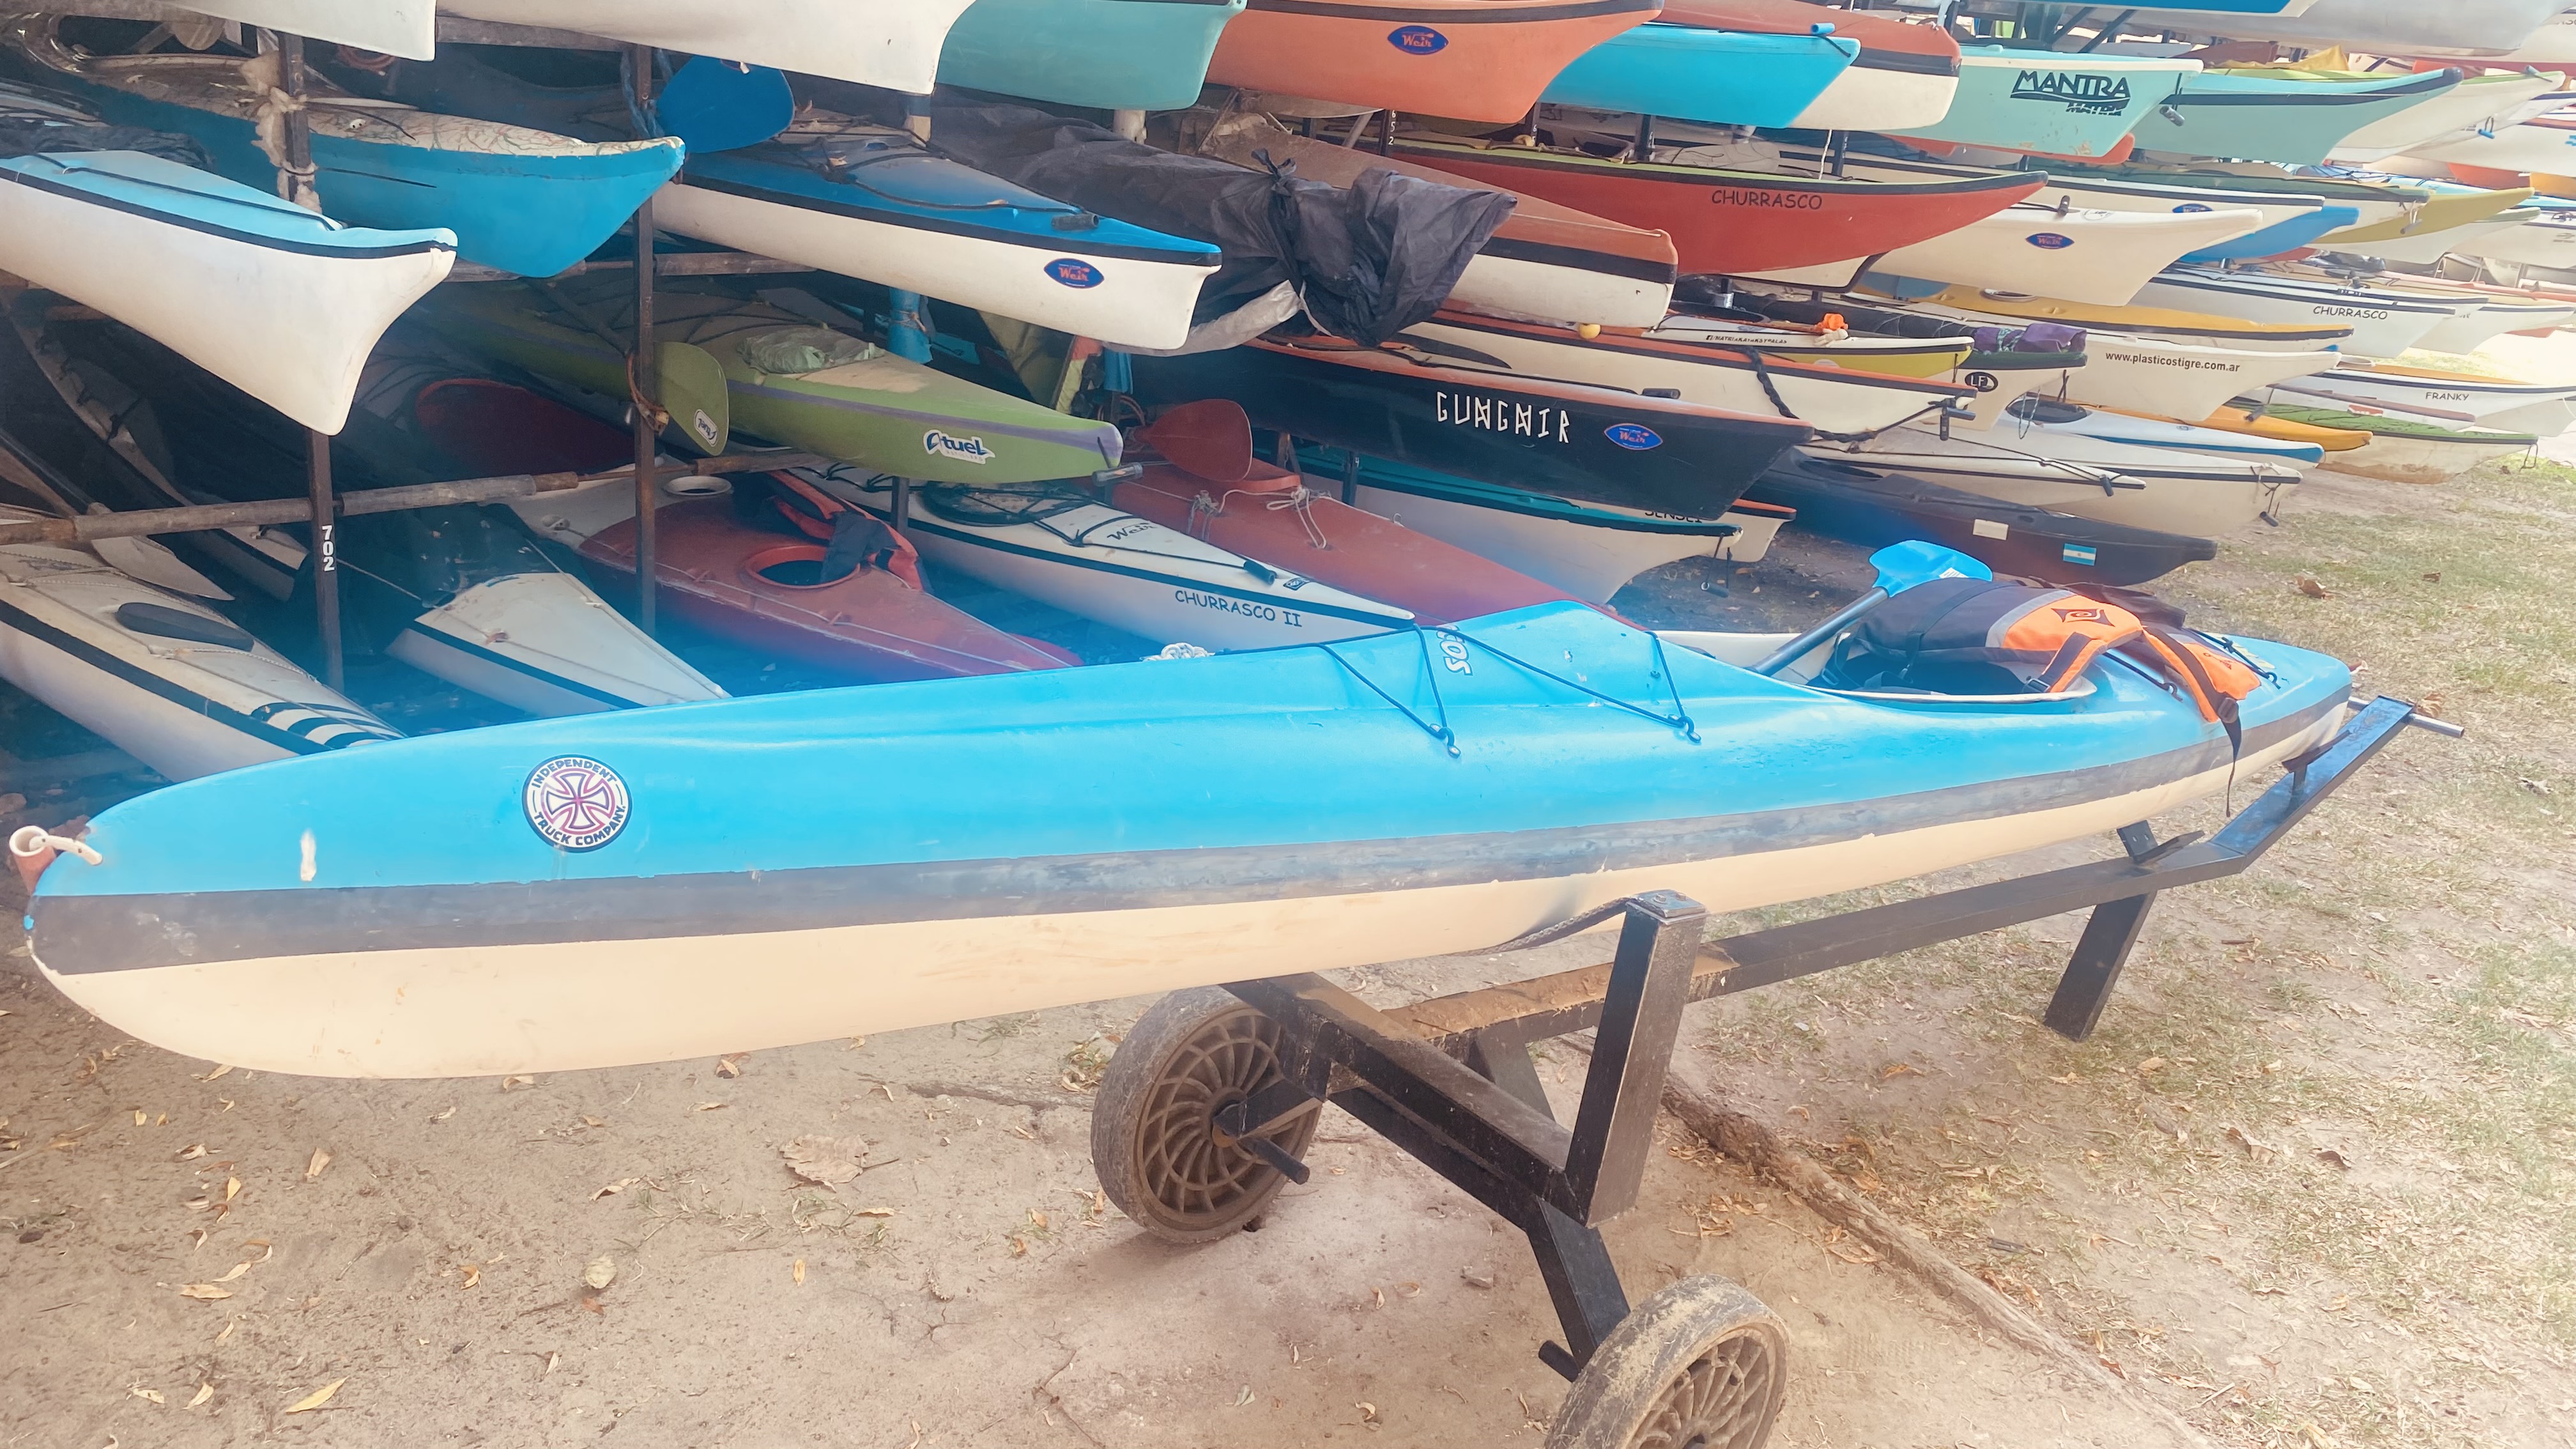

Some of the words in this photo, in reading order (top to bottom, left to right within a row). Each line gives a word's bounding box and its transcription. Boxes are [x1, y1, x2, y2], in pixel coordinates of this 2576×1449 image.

[2011, 70, 2131, 100] MANTRA
[1712, 190, 1822, 210] CHURRASCO
[2313, 305, 2388, 320] CHURRASCO
[2105, 352, 2241, 372] www.plasticostigre.com.ar
[2425, 392, 2469, 401] FRANKY
[322, 525, 335, 572] 702
[1175, 590, 1276, 621] CHURRASCO
[1282, 611, 1303, 627] II
[532, 759, 617, 788] INDEPENDENT
[534, 811, 572, 844] TRUCK
